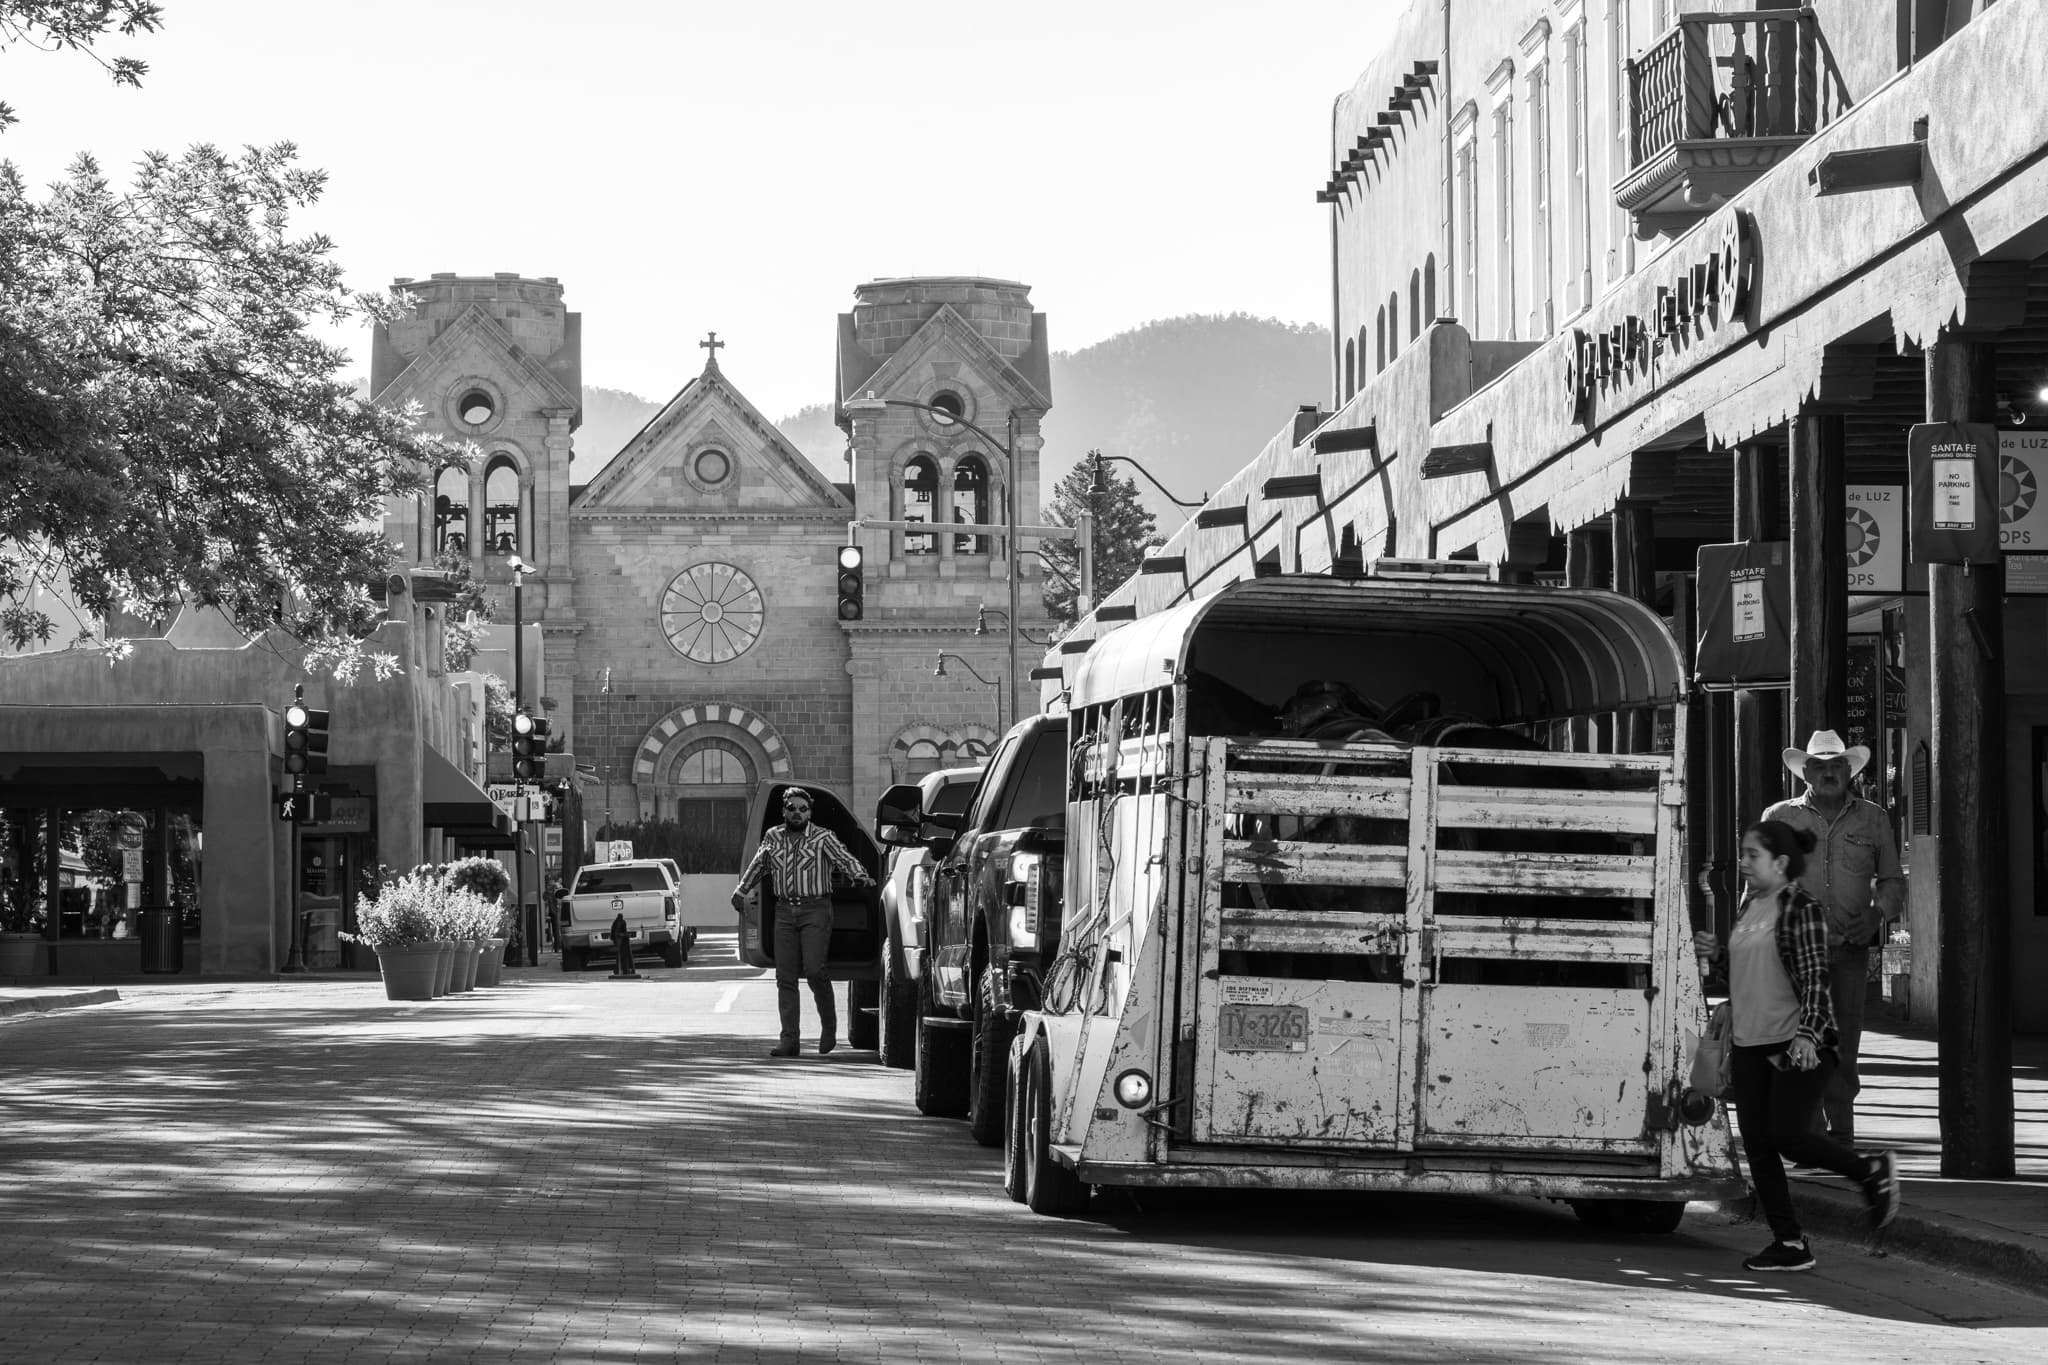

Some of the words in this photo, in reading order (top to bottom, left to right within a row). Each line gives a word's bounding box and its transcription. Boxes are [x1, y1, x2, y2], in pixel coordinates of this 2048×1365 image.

[1584, 315, 1637, 388] PASO
[1652, 286, 1677, 338] de
[1931, 444, 1963, 453] SANTA
[1965, 444, 1977, 453] FE
[2001, 438, 2015, 449] de
[2021, 438, 2048, 449] LUZ
[1848, 492, 1861, 502] de
[1866, 492, 1891, 502] LUZ
[1999, 531, 2031, 544] OPS
[1730, 569, 1755, 578] SANTA
[1755, 567, 1765, 575] FE
[1847, 574, 1875, 585] OPS
